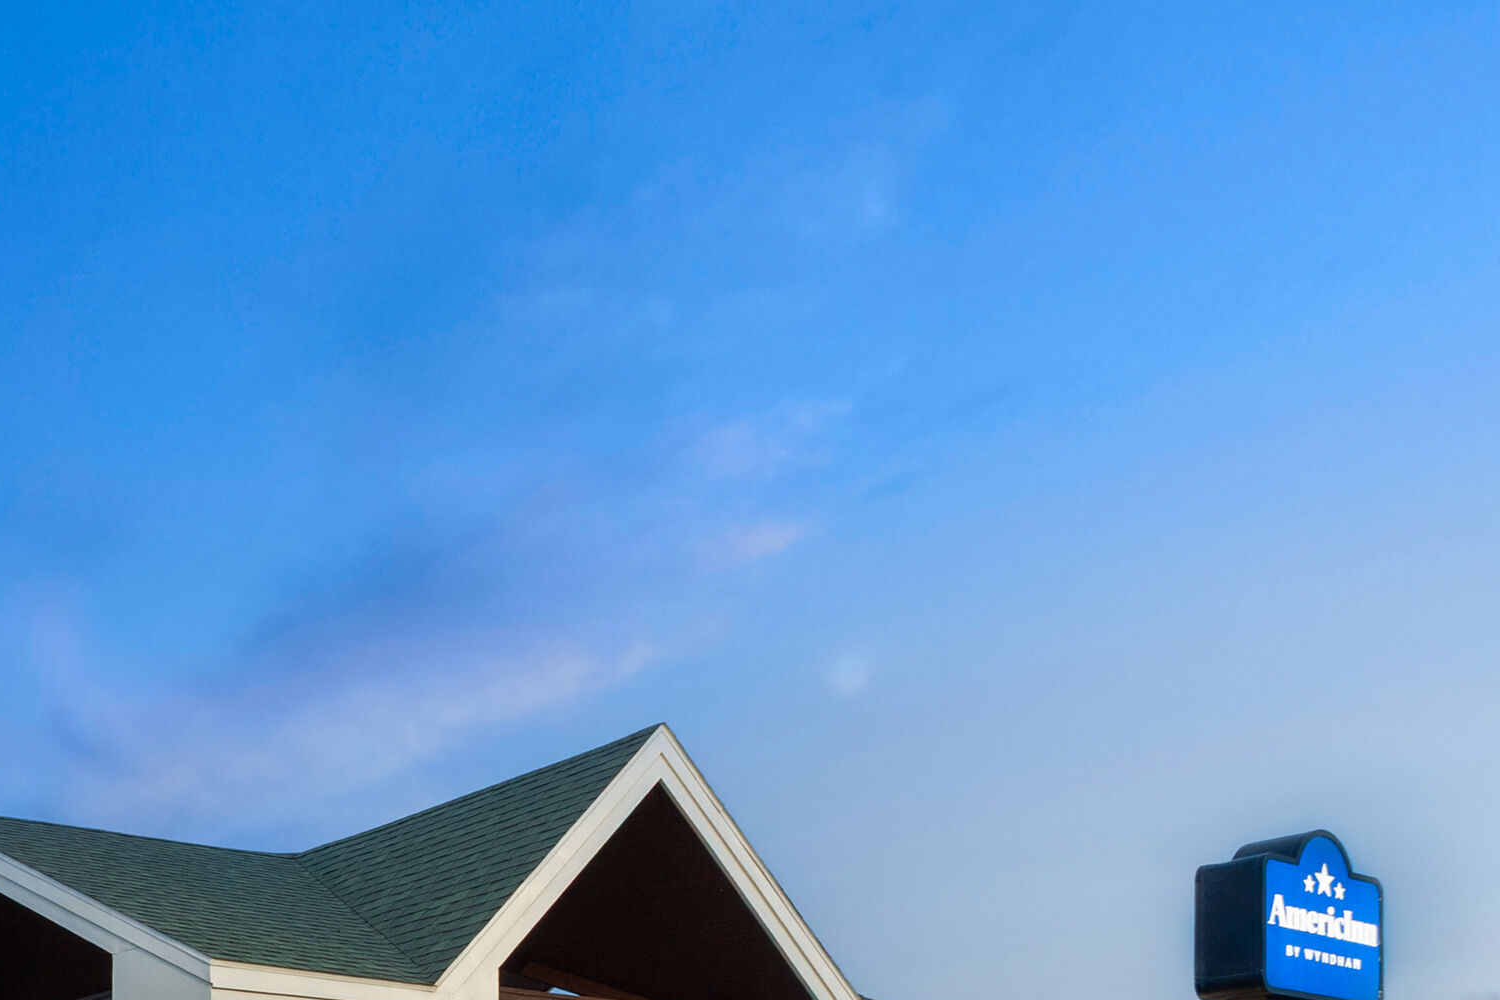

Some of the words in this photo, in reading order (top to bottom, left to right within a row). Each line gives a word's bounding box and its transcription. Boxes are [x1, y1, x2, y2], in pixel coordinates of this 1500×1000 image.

[1267, 893, 1378, 947] AmericInn
[1285, 944, 1301, 958] BY
[1303, 948, 1362, 970] WYNDHAM
